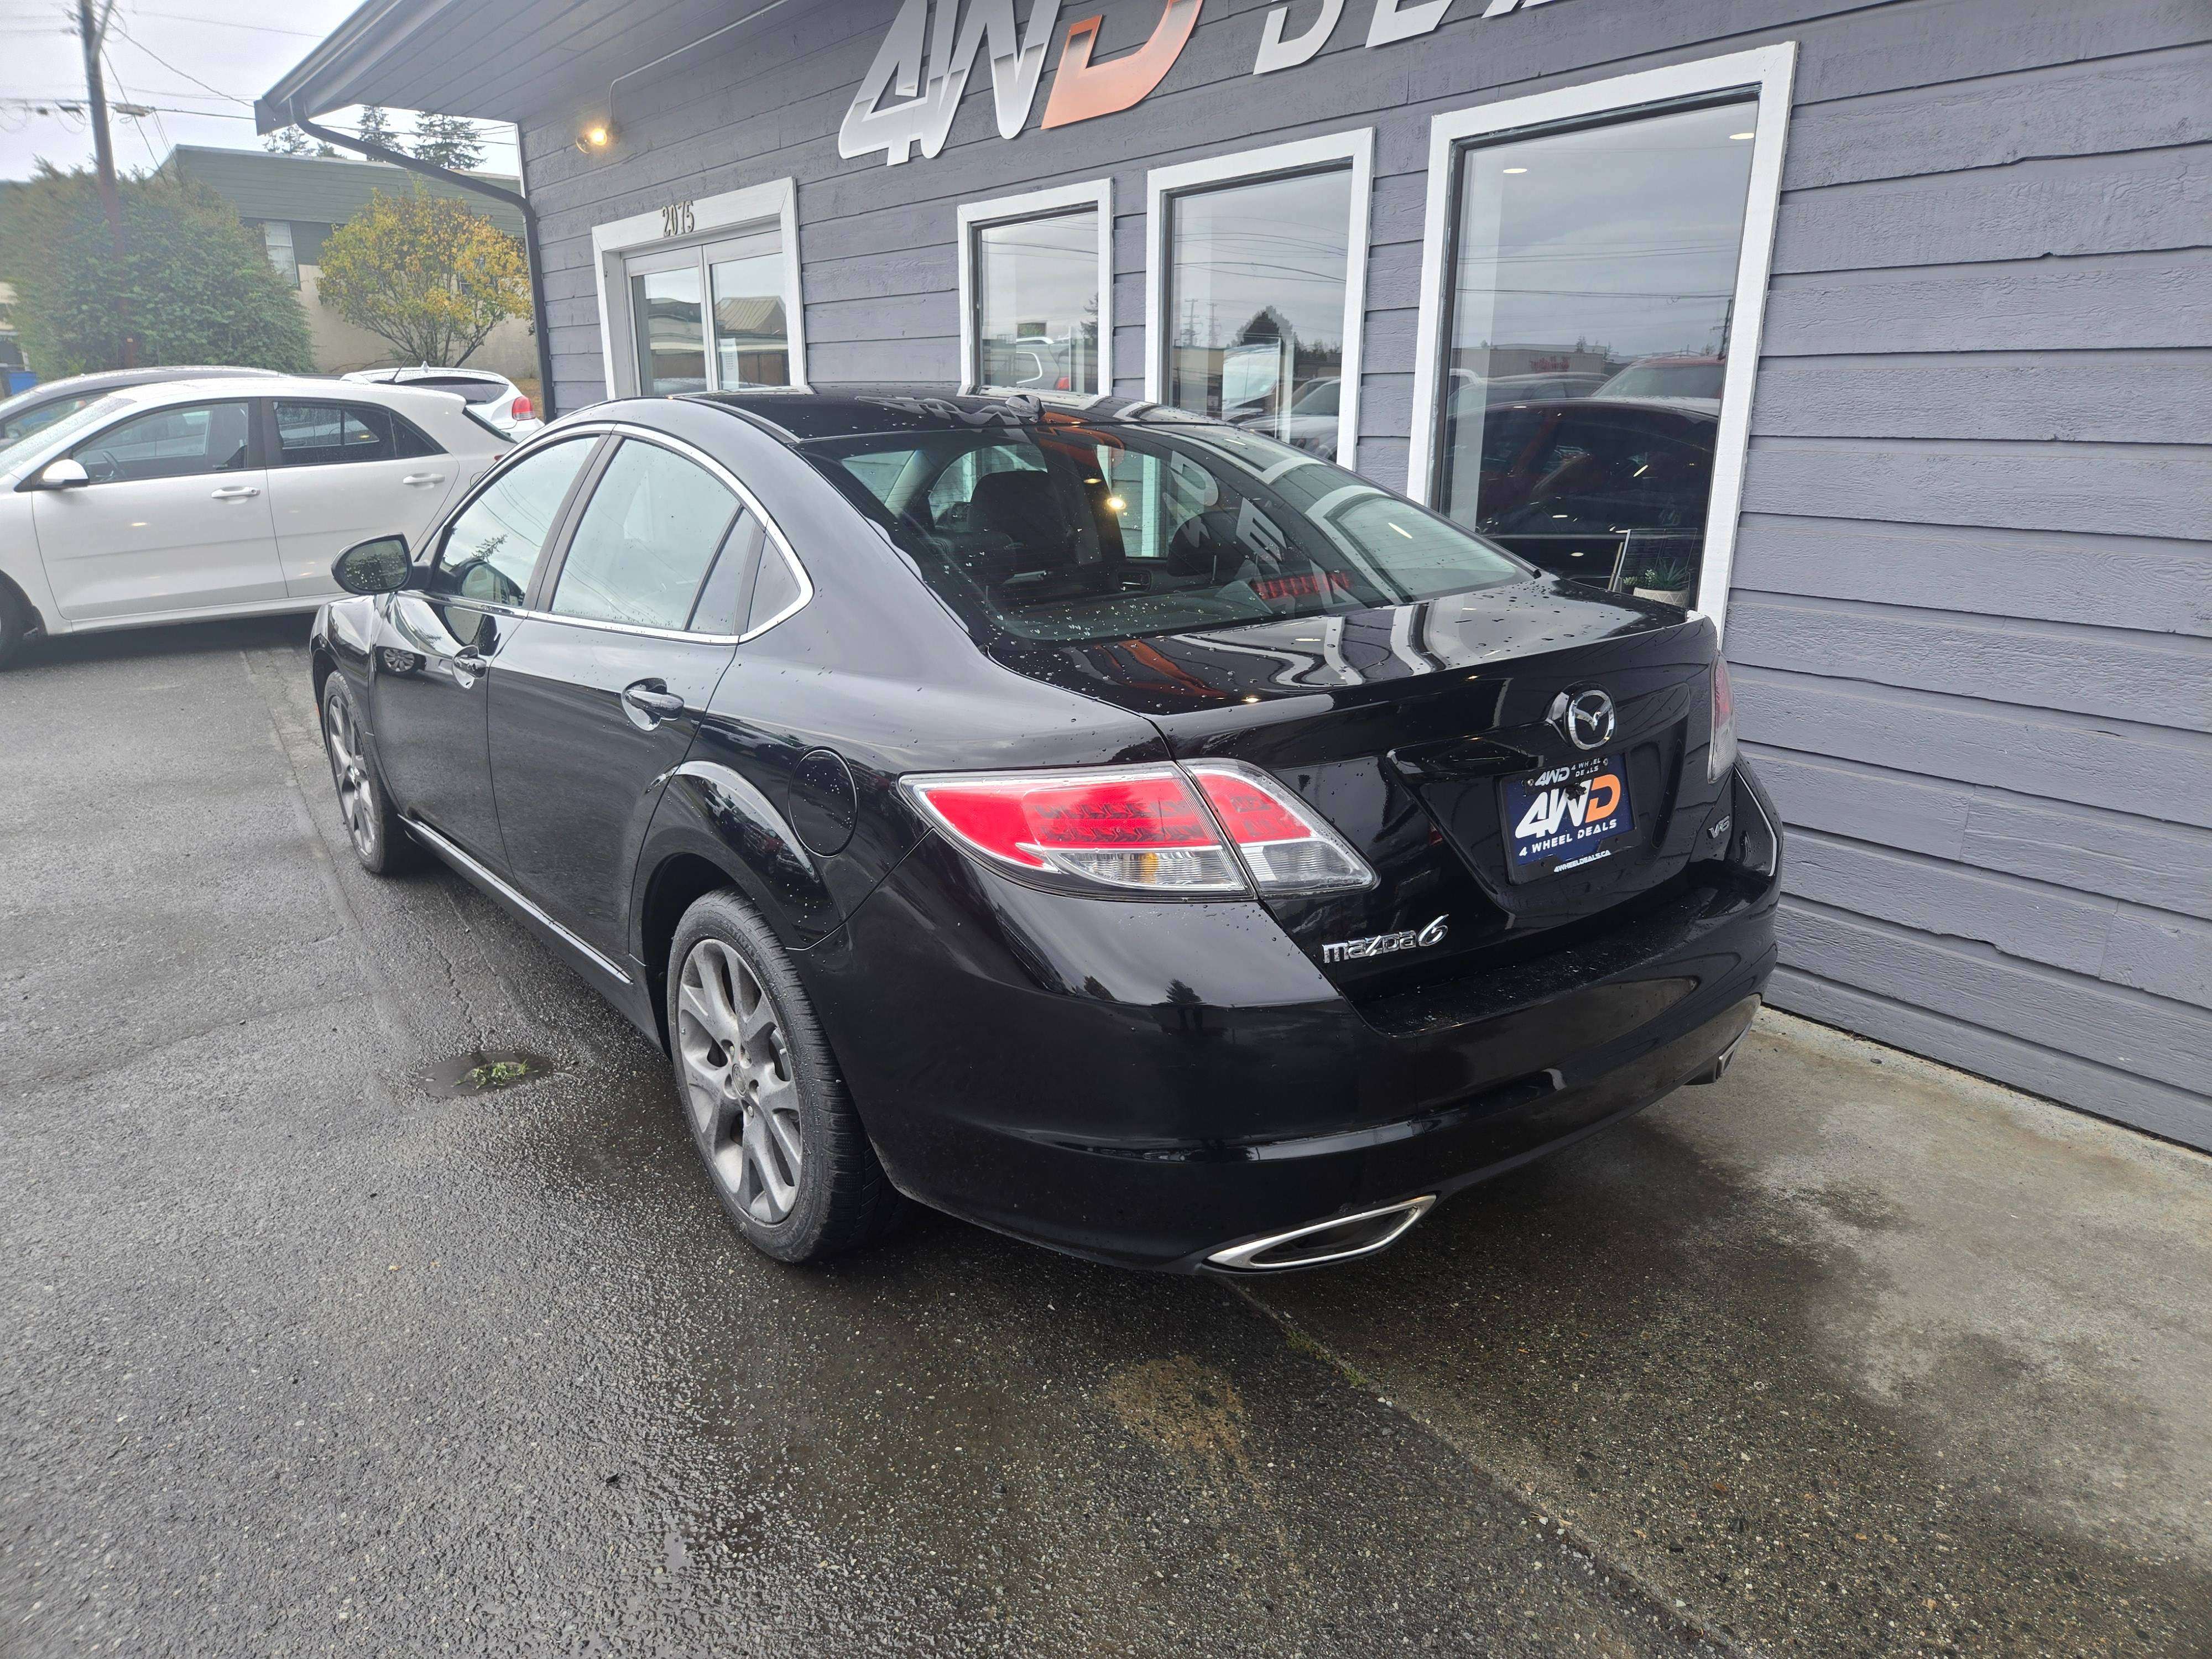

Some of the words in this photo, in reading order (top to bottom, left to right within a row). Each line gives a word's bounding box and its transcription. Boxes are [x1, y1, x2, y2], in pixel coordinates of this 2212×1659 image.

[662, 200, 695, 236] 2075
[1535, 766, 1570, 786] 4WD
[1515, 774, 1621, 839] 4WD
[1519, 847, 1527, 856] 4
[1532, 834, 1573, 853] WHEEL
[1577, 819, 1618, 839] DEALS
[1708, 815, 1730, 838] V6
[1554, 849, 1611, 873] 4WHEELDEALS.CA
